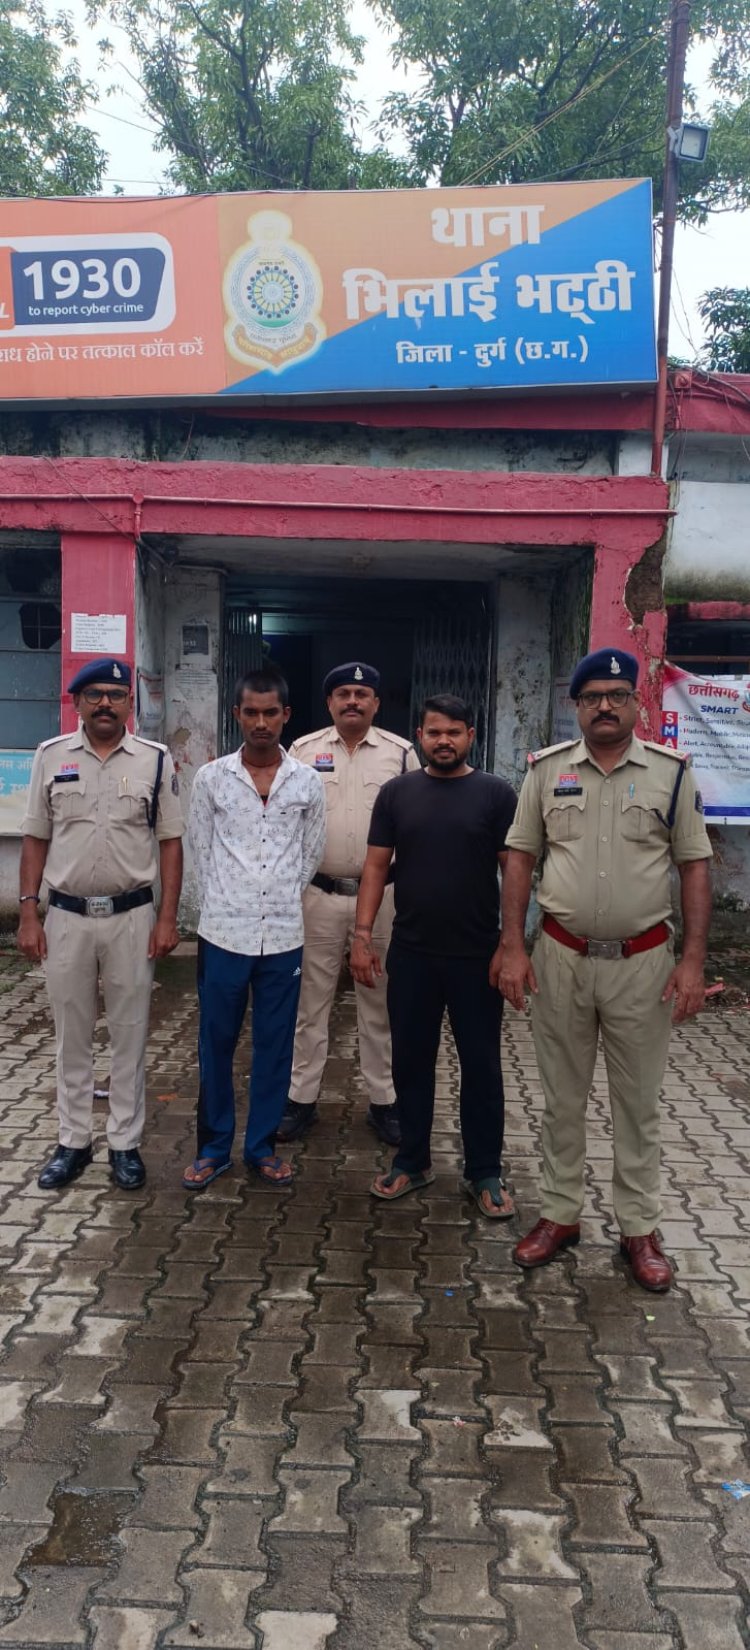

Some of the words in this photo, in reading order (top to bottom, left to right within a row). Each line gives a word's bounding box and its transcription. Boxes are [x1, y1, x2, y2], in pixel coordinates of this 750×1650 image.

[431, 204, 545, 247] थाना
[23, 257, 141, 300] 1930
[342, 262, 500, 322] भिलाई
[516, 260, 636, 325] भट्ठी
[28, 306, 41, 316] to
[43, 305, 78, 318] report
[81, 303, 110, 316] cyber
[113, 302, 144, 313] crime
[26, 342, 54, 363] होने
[58, 346, 80, 360] पर
[82, 344, 136, 359] तत्काल
[140, 338, 175, 358] कॉल
[178, 337, 205, 356] करें
[396, 340, 453, 364] जिला
[474, 337, 507, 368] दुर्ग
[515, 335, 589, 365] (छ.ग.)
[665, 713, 674, 724] S
[700, 704, 739, 715] SMART
[664, 726, 675, 736] M
